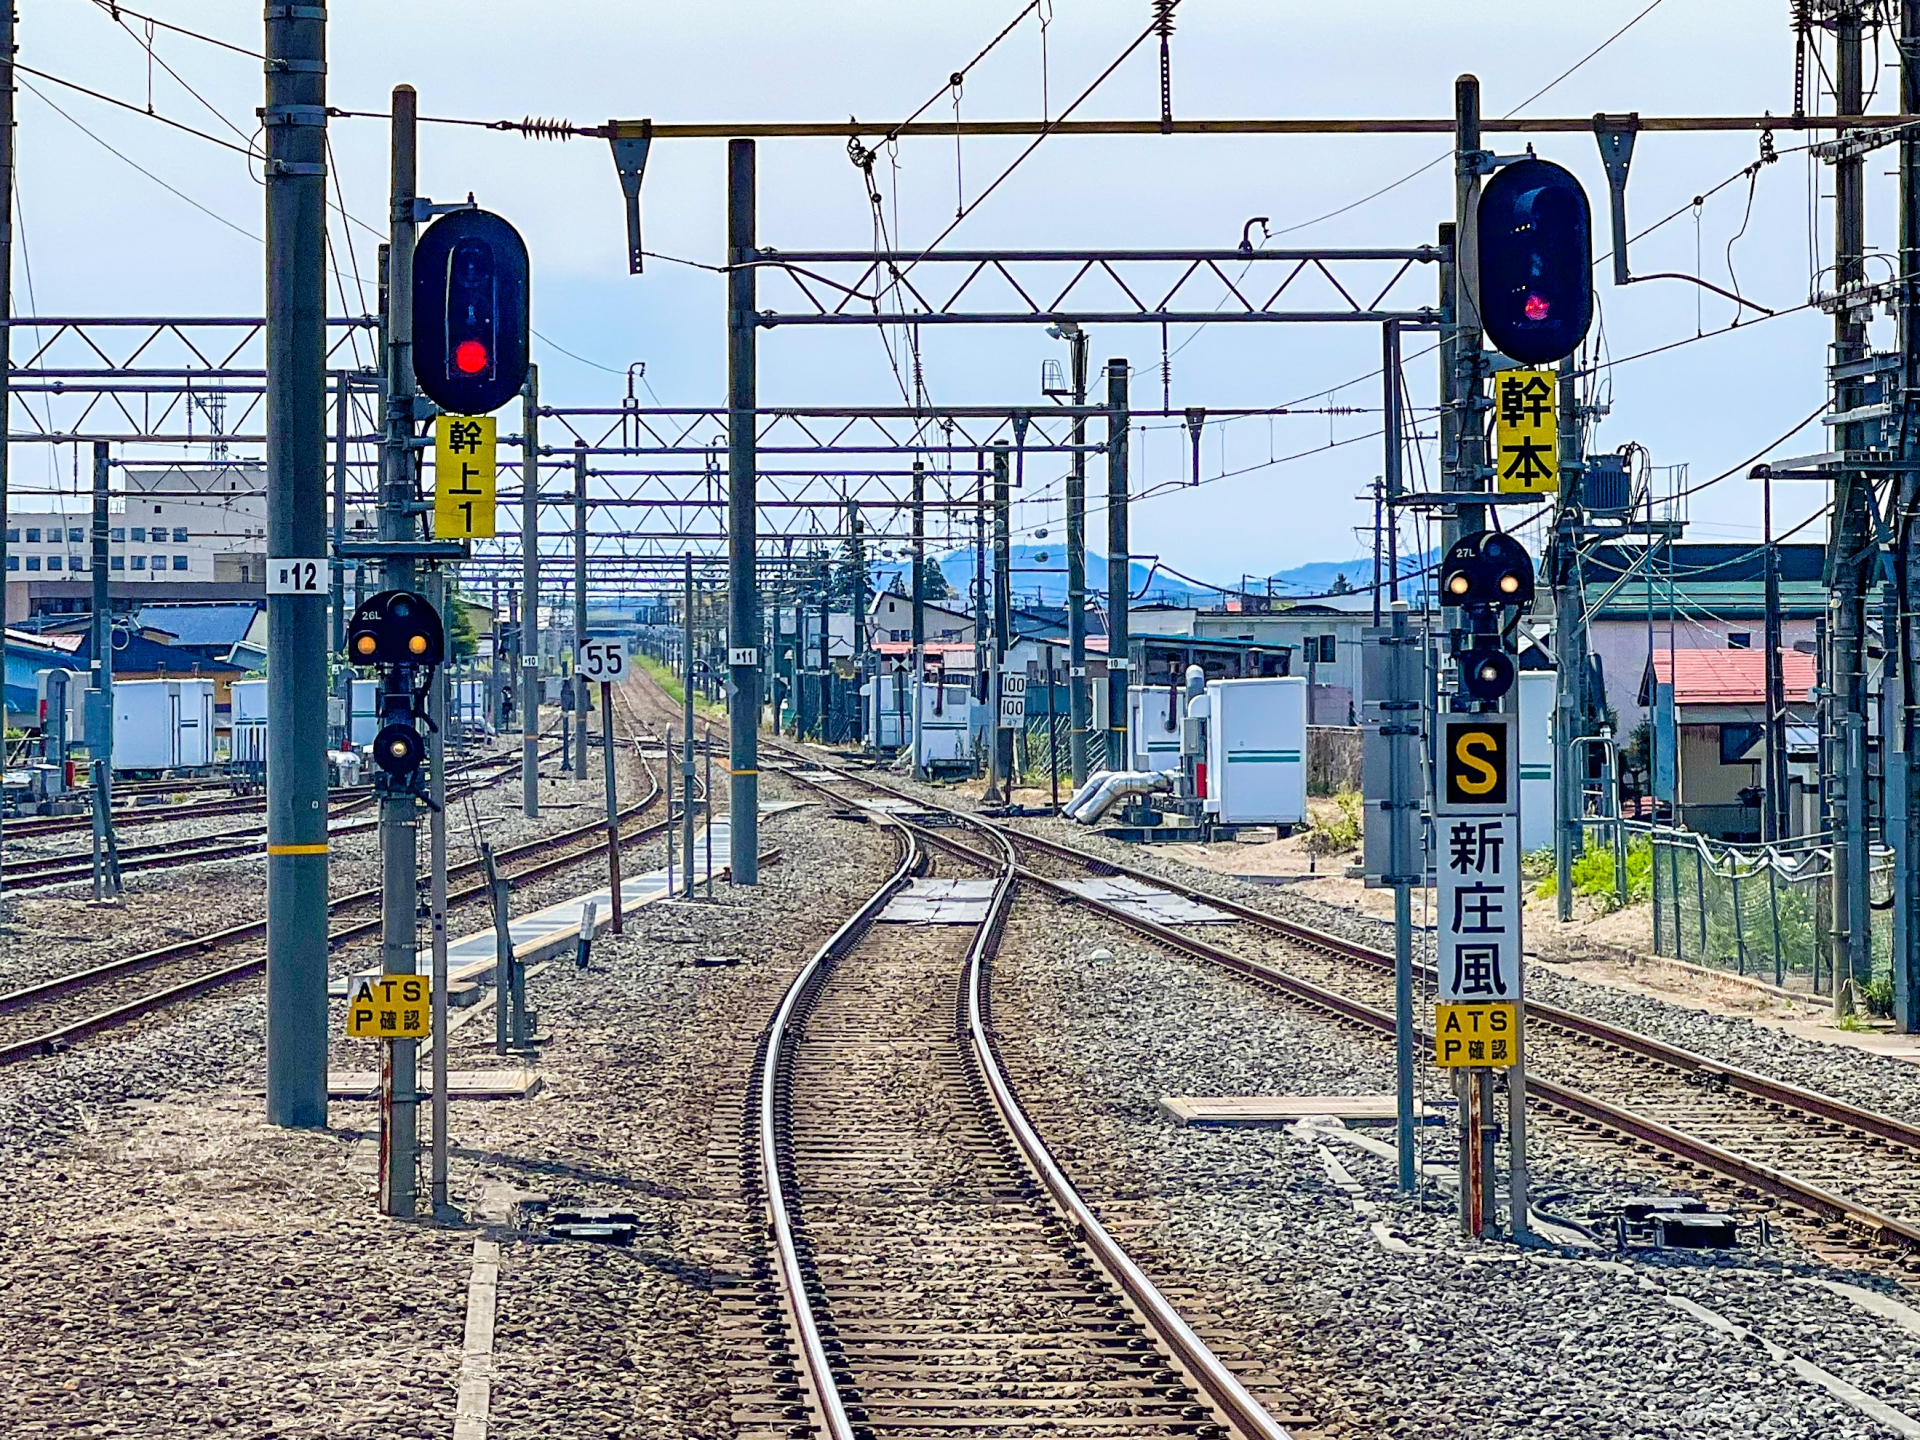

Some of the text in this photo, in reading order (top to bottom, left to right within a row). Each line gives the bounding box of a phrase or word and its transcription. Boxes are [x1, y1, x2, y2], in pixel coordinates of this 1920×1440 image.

[1501, 376, 1553, 488] 幹本
[448, 421, 482, 533] 幹上1
[1456, 548, 1476, 558] 27L
[291, 562, 317, 591] 12
[362, 611, 382, 620] 26L
[587, 645, 622, 675] 55
[1004, 677, 1025, 692] 100
[1003, 700, 1023, 715] 100
[1456, 732, 1498, 795] S
[1450, 821, 1507, 996] 新庄風
[356, 981, 421, 1002] ATS
[1444, 1010, 1508, 1033] ATS
